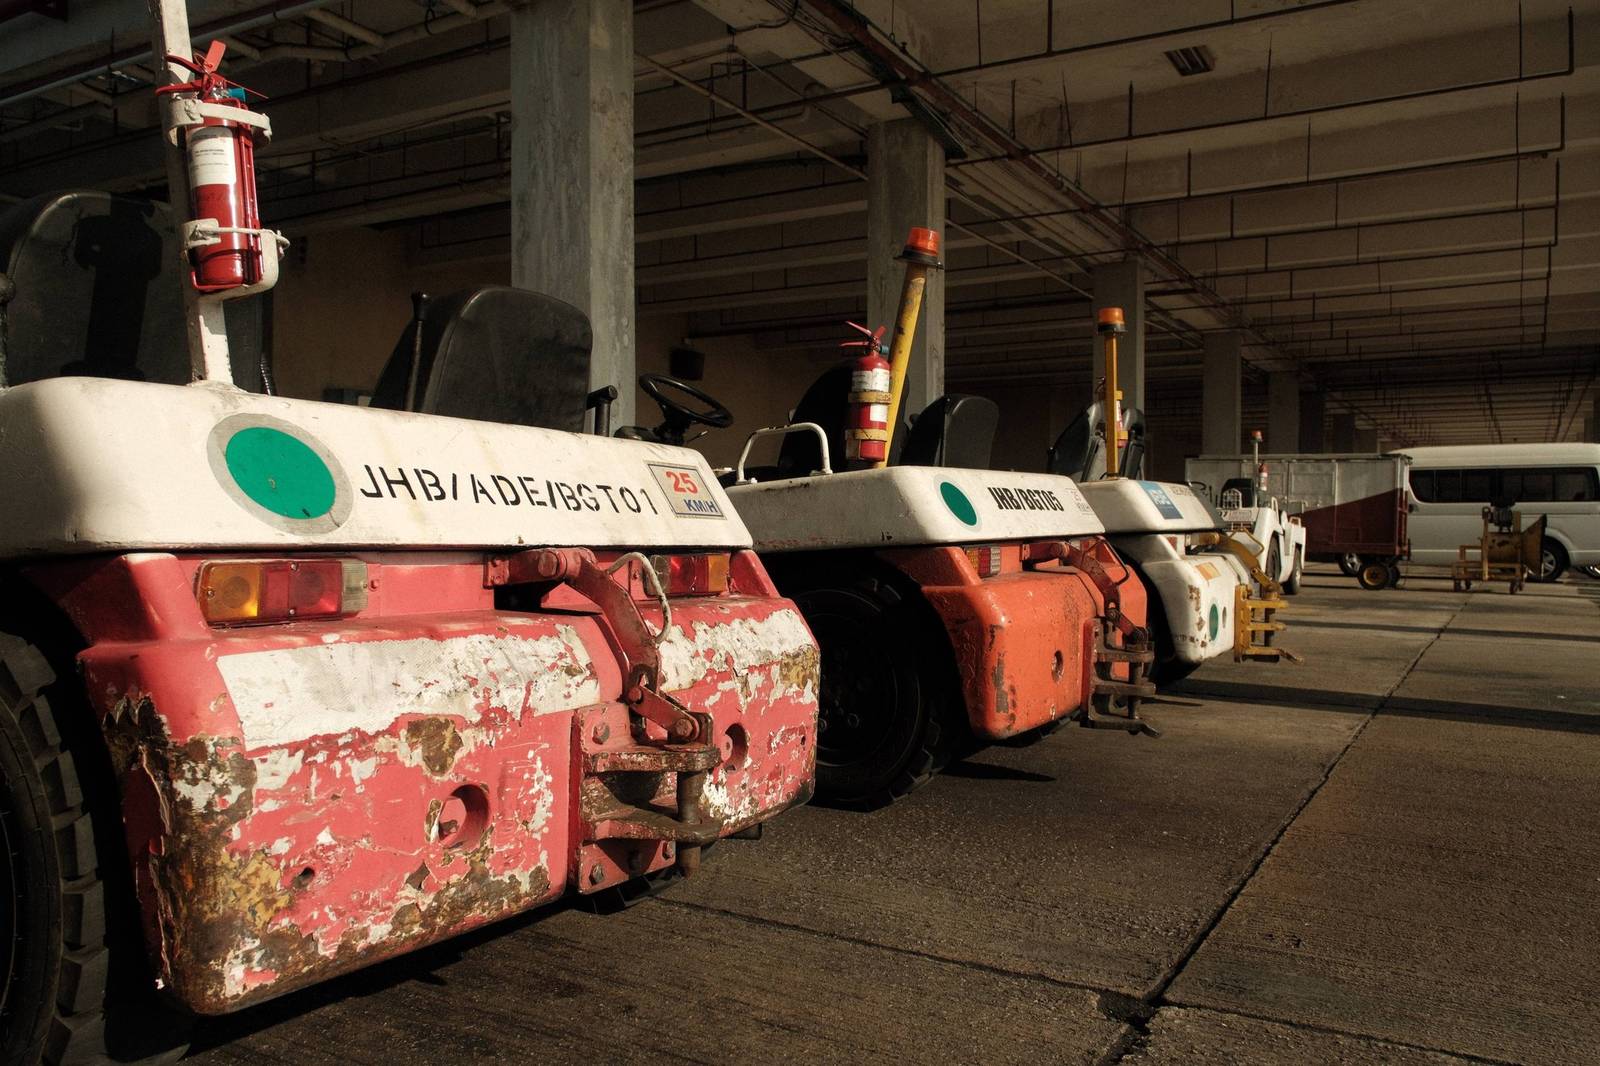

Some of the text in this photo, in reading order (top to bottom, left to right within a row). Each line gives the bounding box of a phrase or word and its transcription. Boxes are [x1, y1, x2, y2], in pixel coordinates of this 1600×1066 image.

[666, 471, 698, 494] 25
[683, 499, 718, 513] KM/H
[987, 487, 1064, 511] JHB/BGT05
